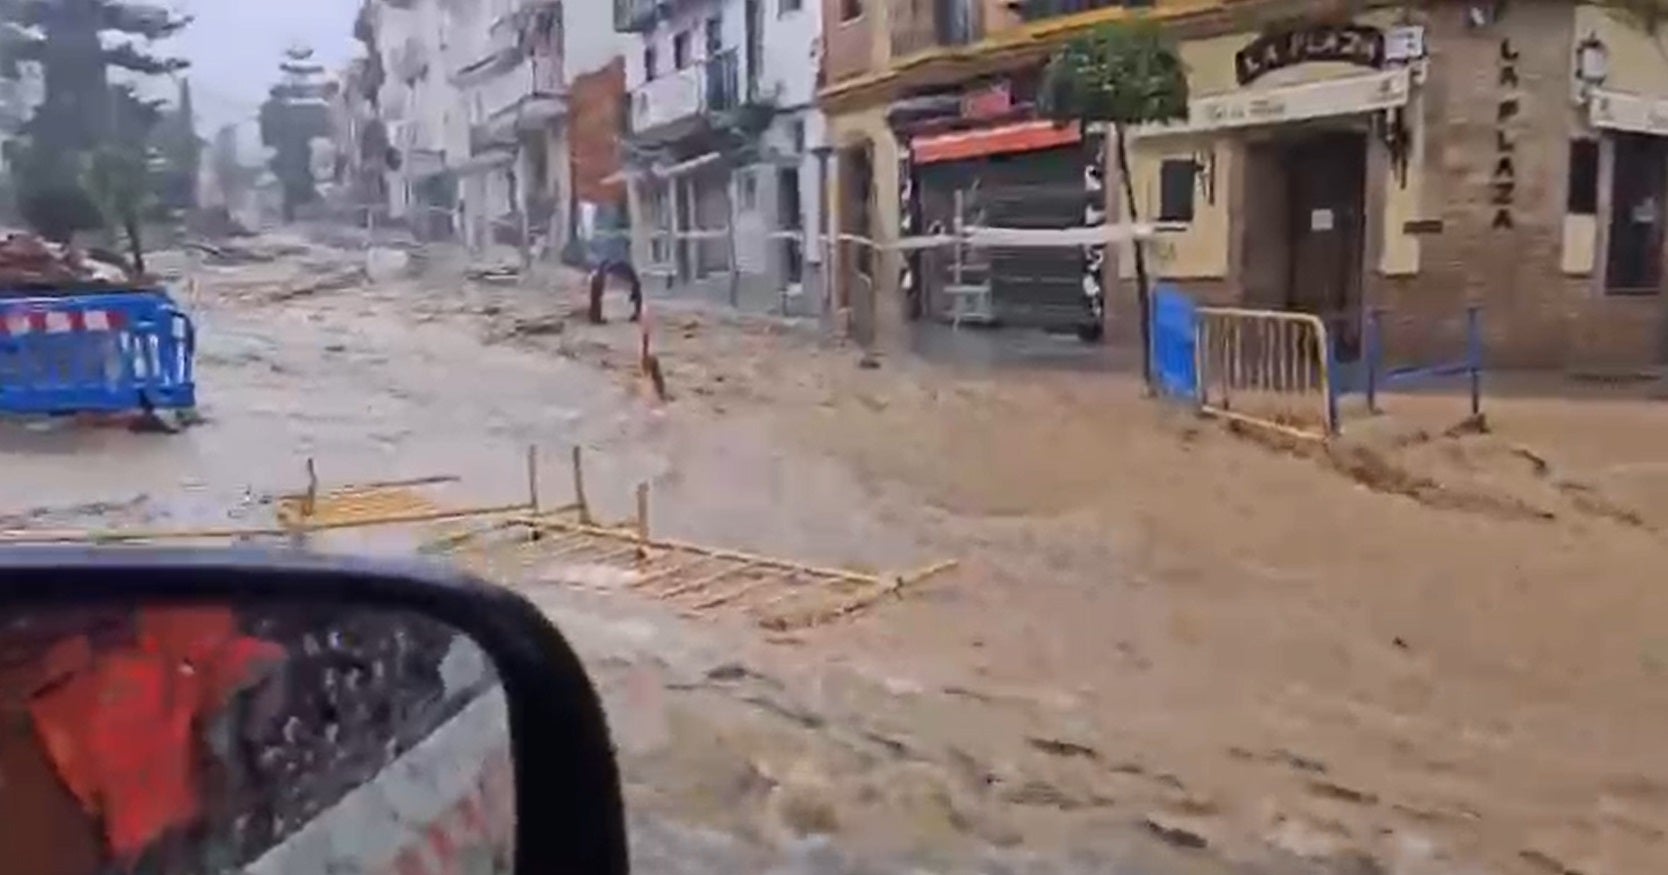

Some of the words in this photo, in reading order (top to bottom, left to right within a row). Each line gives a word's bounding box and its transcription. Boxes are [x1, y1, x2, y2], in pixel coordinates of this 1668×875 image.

[1243, 43, 1278, 73] LA
[1289, 29, 1377, 63] PLAZA
[1500, 38, 1519, 87] LA
[1492, 100, 1519, 229] PLAZA
